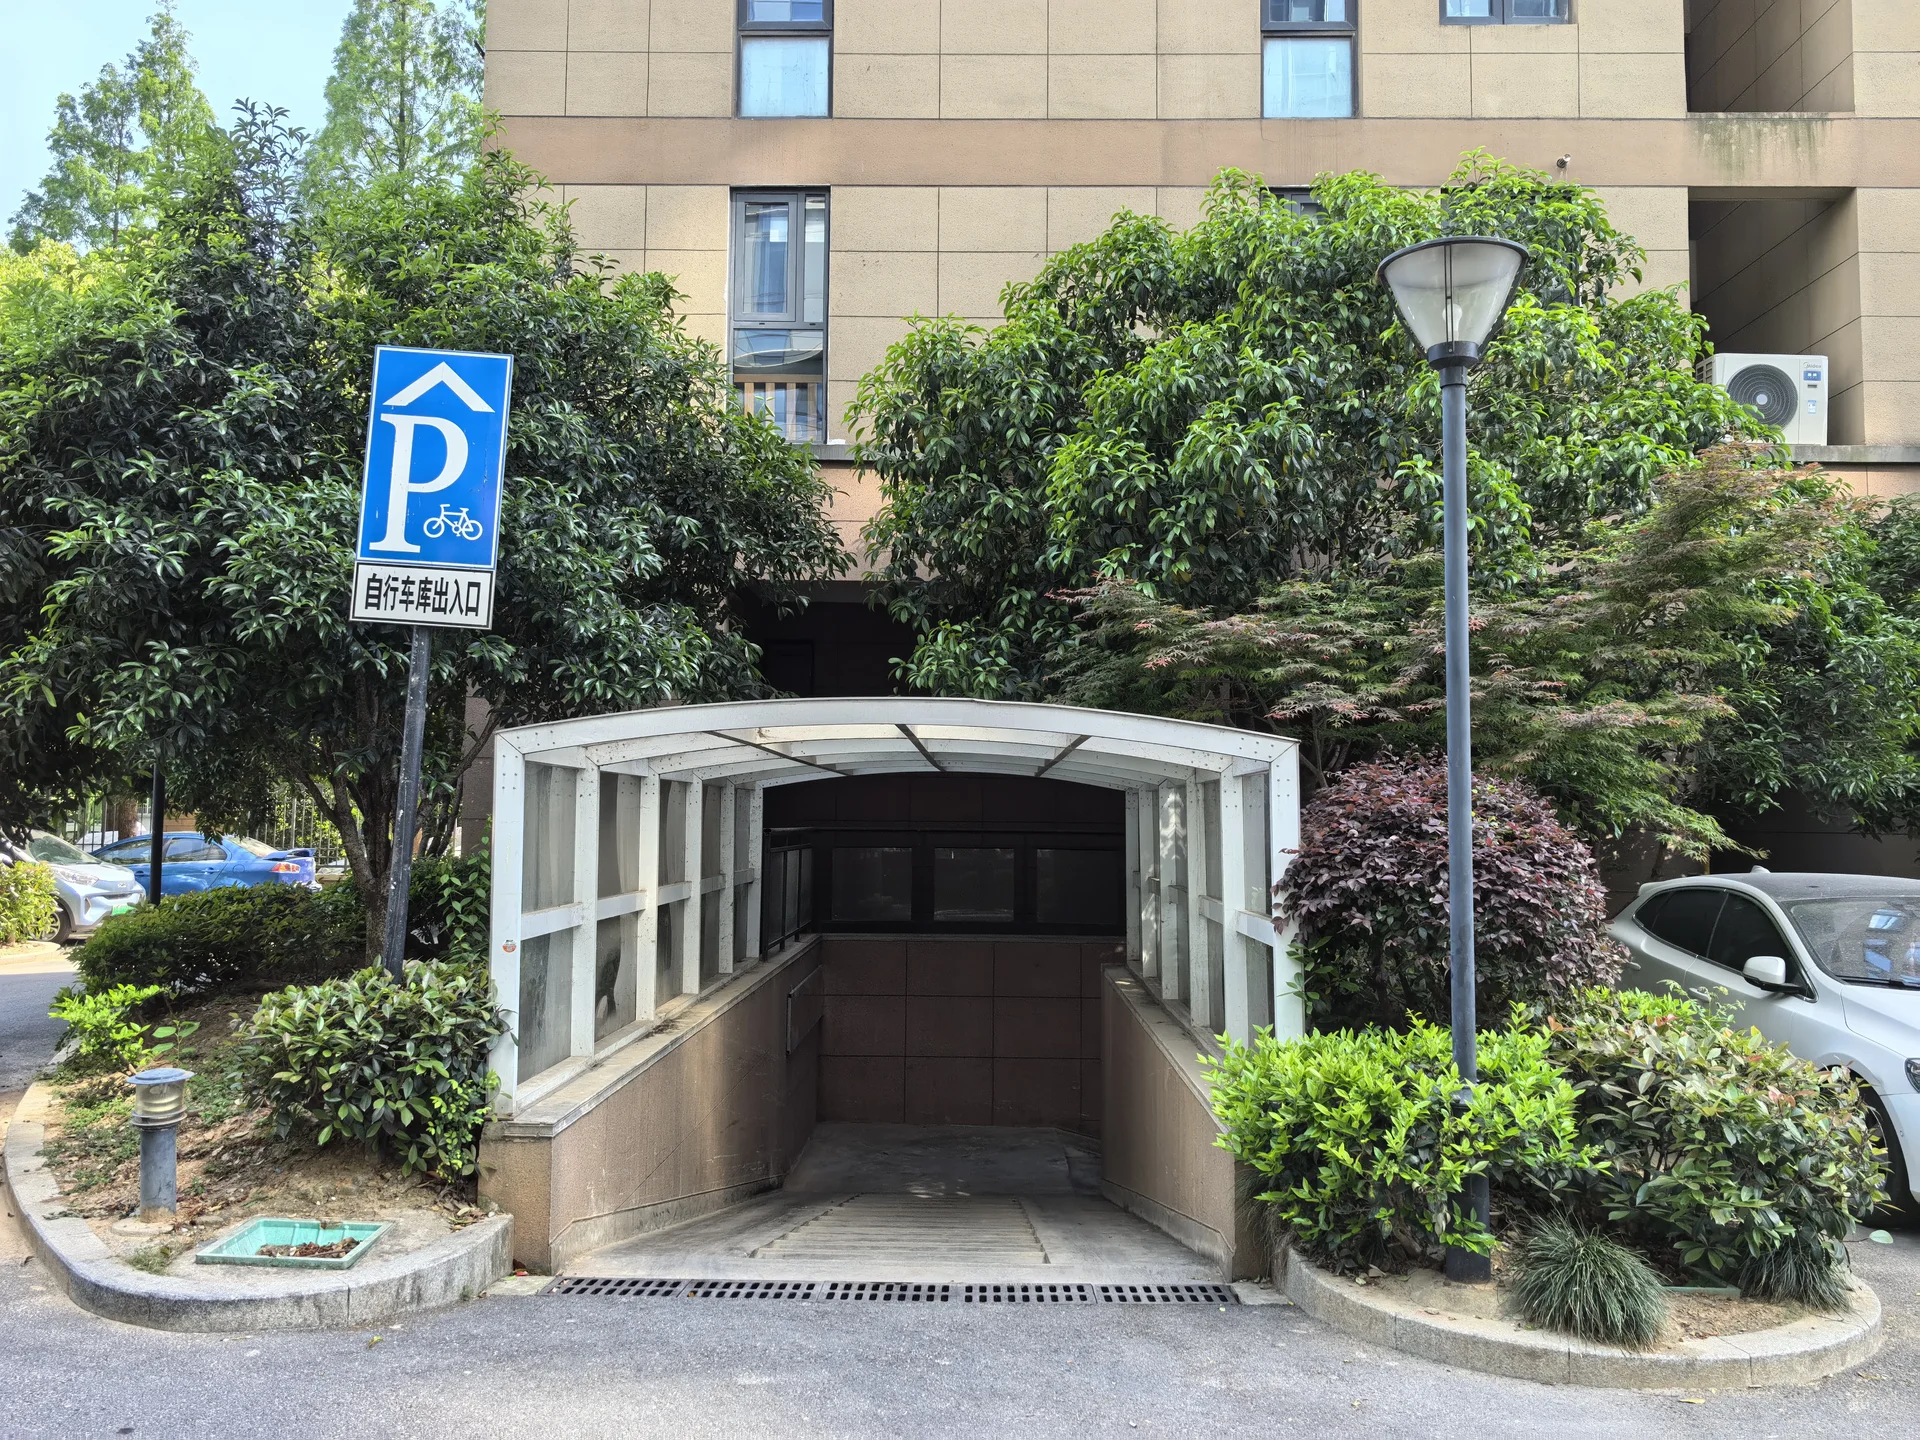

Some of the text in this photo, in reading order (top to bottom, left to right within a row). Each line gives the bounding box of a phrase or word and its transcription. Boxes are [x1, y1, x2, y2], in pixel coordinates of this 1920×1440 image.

[369, 413, 469, 553] P
[365, 573, 481, 617] 自行车库出入口
